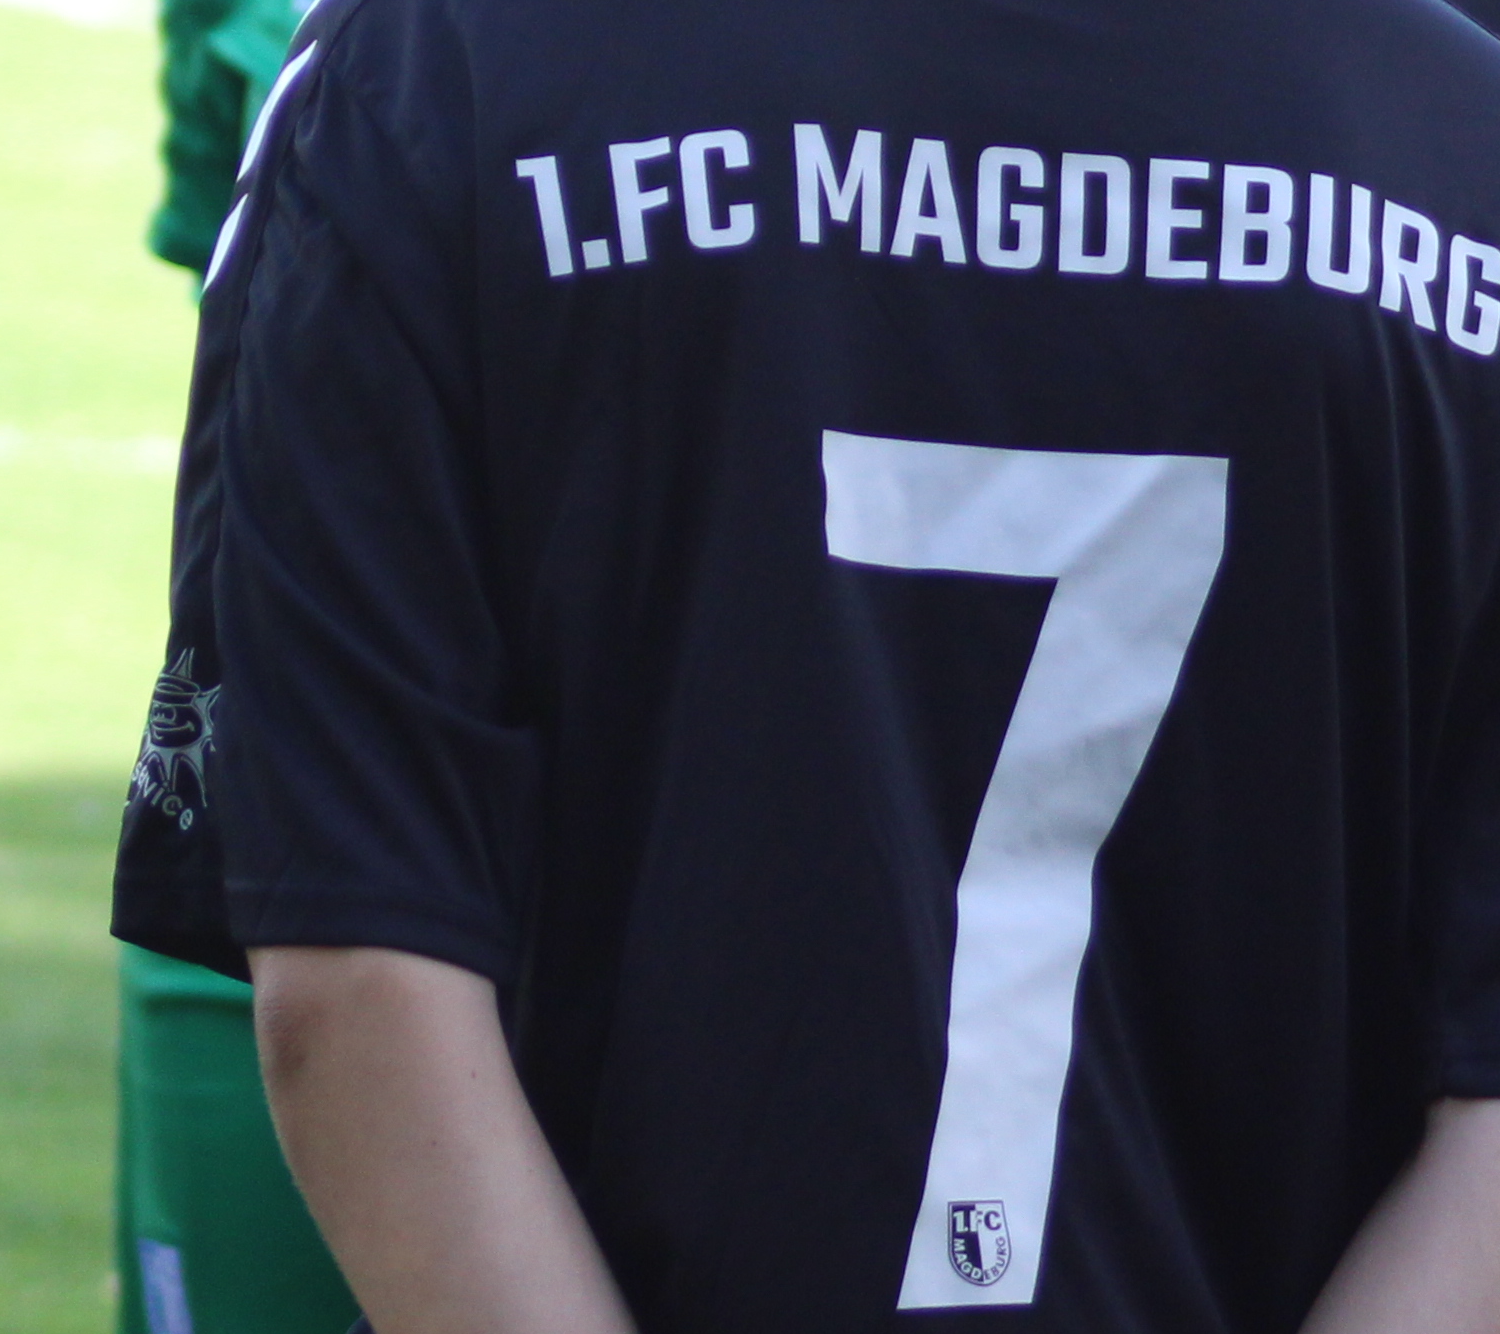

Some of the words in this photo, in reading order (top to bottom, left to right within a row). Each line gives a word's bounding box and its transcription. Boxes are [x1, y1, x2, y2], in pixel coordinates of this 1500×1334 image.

[516, 128, 757, 277] 1.FC
[821, 430, 1229, 1310] 7
[953, 1210, 1002, 1233] 1.FC
[953, 1236, 1007, 1280] MAGDEBURG
